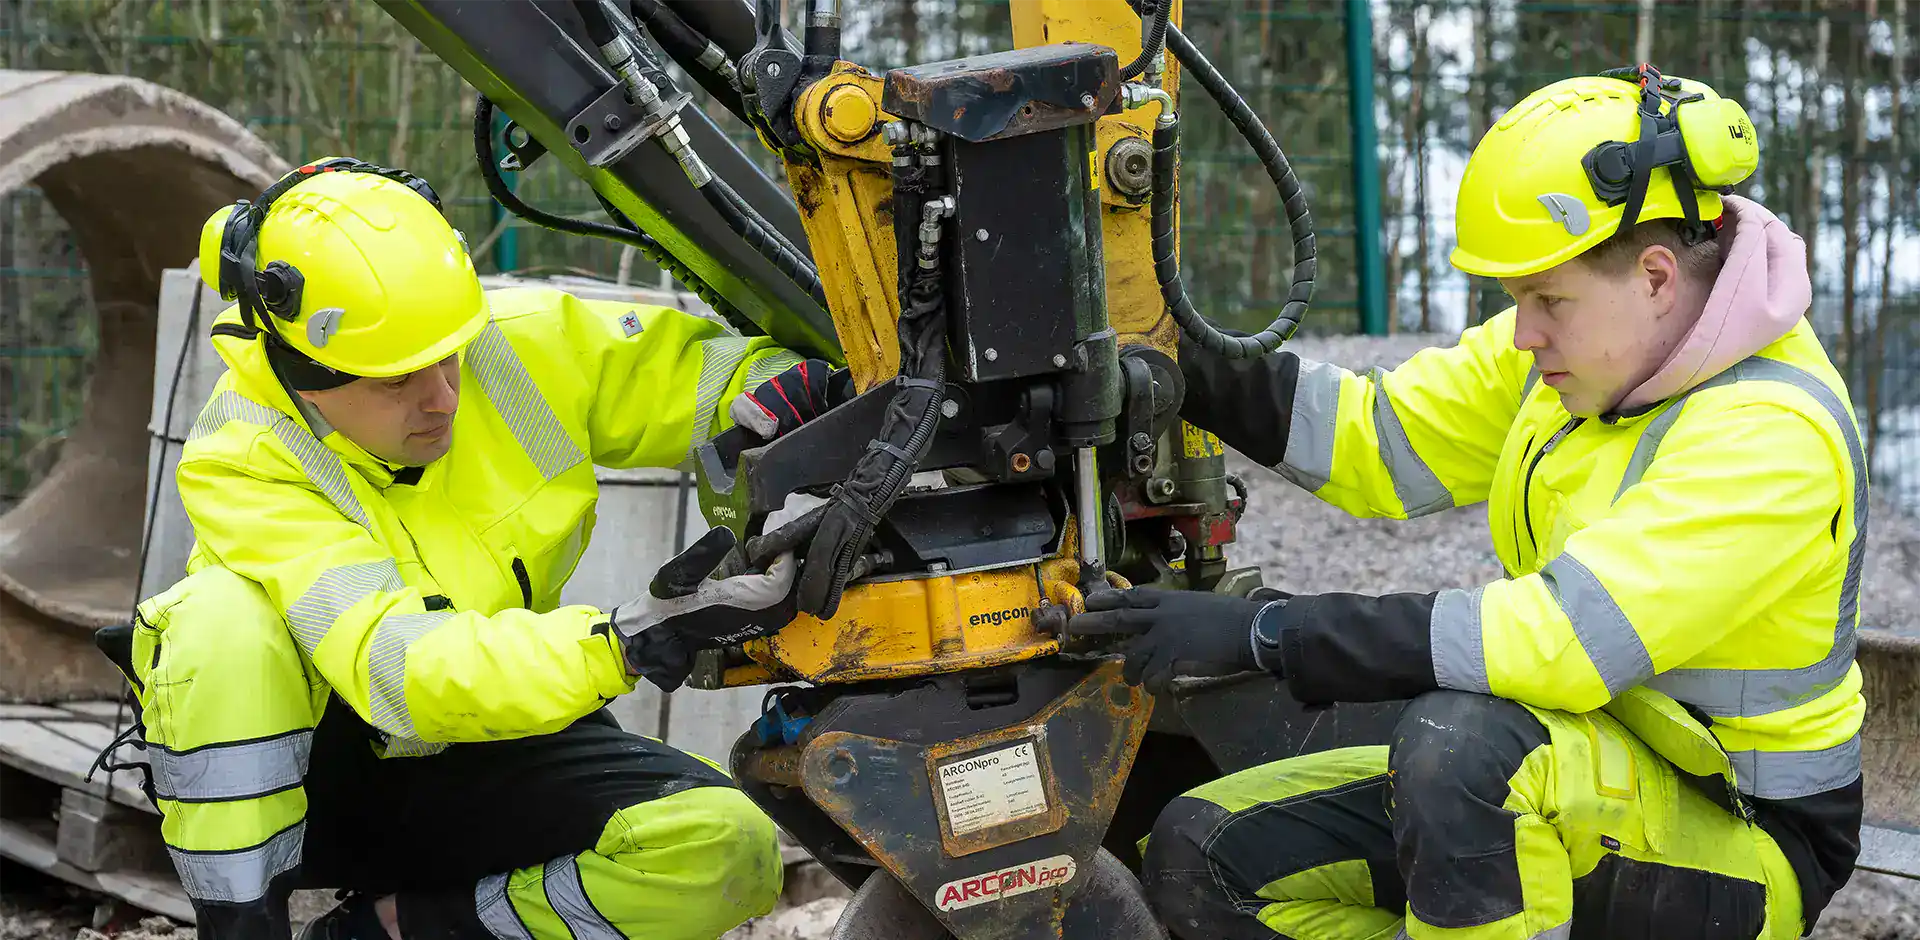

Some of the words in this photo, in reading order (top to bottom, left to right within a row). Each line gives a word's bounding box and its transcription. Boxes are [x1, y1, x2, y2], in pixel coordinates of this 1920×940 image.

[969, 606, 1029, 626] engcon
[943, 757, 1000, 778] ARCONpro
[941, 865, 1036, 907] ARCON
